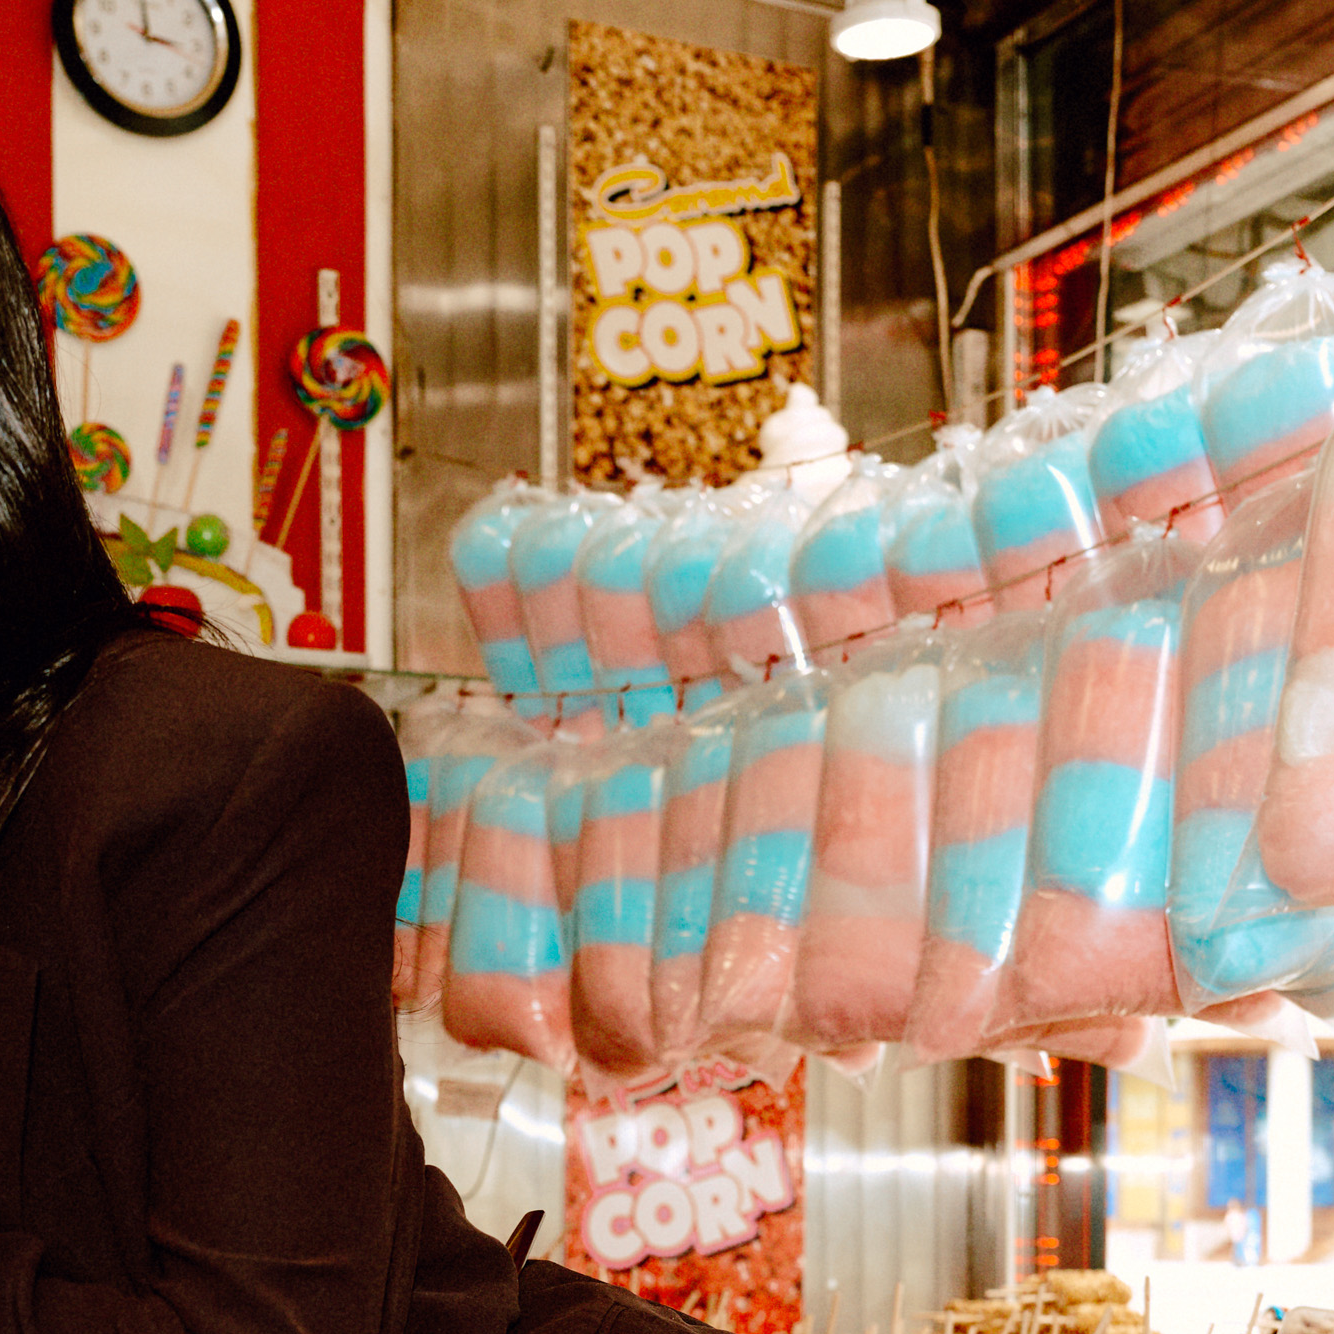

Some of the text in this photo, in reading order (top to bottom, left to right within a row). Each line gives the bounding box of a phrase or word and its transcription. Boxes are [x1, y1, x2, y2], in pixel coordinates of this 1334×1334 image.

[585, 221, 747, 298] POP
[593, 273, 795, 379] CORN
[584, 1095, 739, 1186] POP
[587, 1136, 788, 1261] CORN
